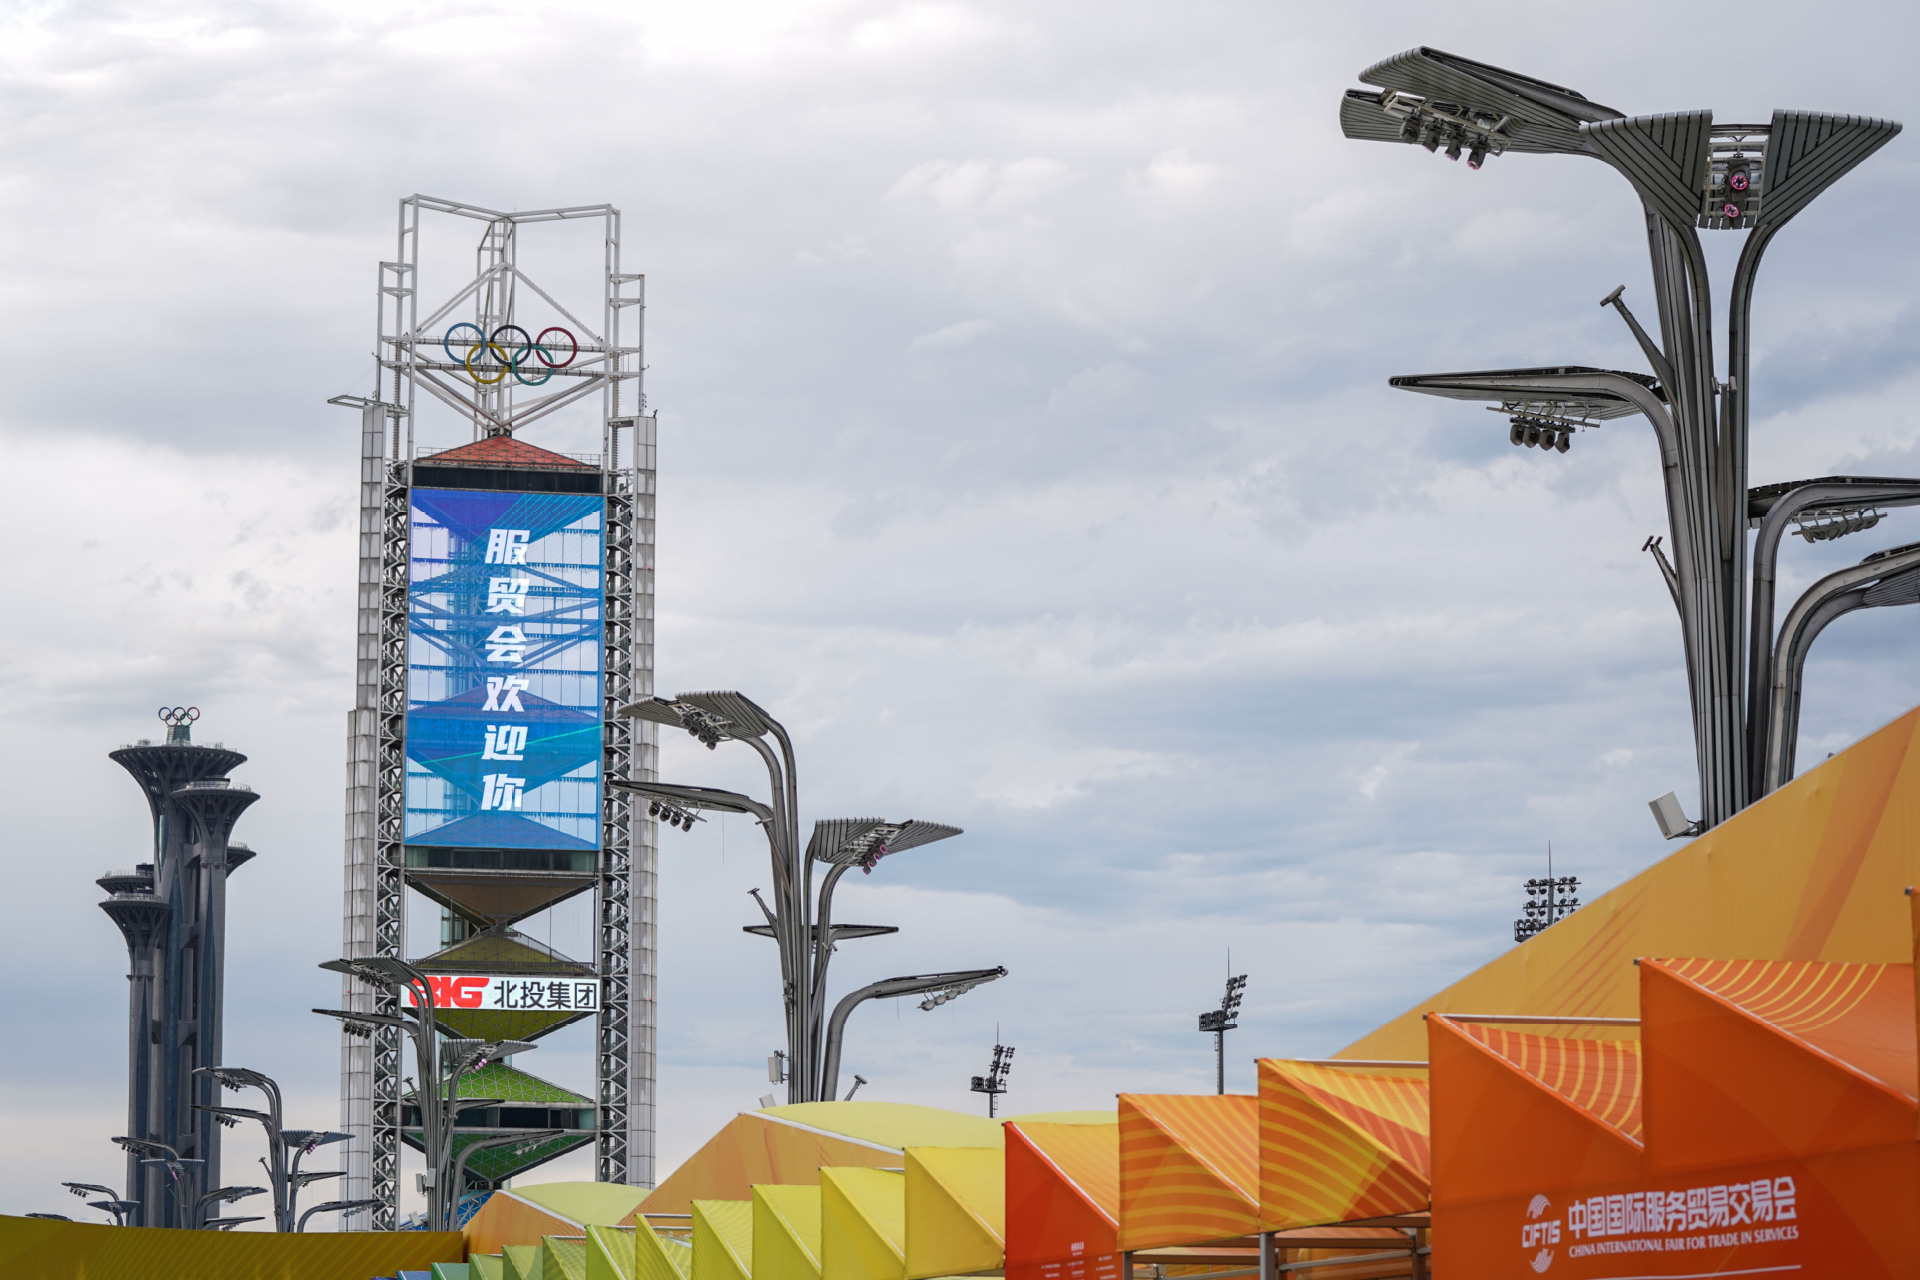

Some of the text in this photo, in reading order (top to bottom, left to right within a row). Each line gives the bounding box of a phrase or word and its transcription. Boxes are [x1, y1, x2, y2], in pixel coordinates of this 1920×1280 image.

[480, 528, 531, 811] 服贸会欢迎你
[409, 976, 490, 1008] BIG
[494, 980, 597, 1009] 北投集团
[1568, 1176, 1797, 1239] 中国国际服务贸易交易会
[1522, 1220, 1561, 1248] CIFTIS
[1568, 1225, 1799, 1258] CHINA INTERNATIONAL FAIR FOR TRADE IN SERVICES
